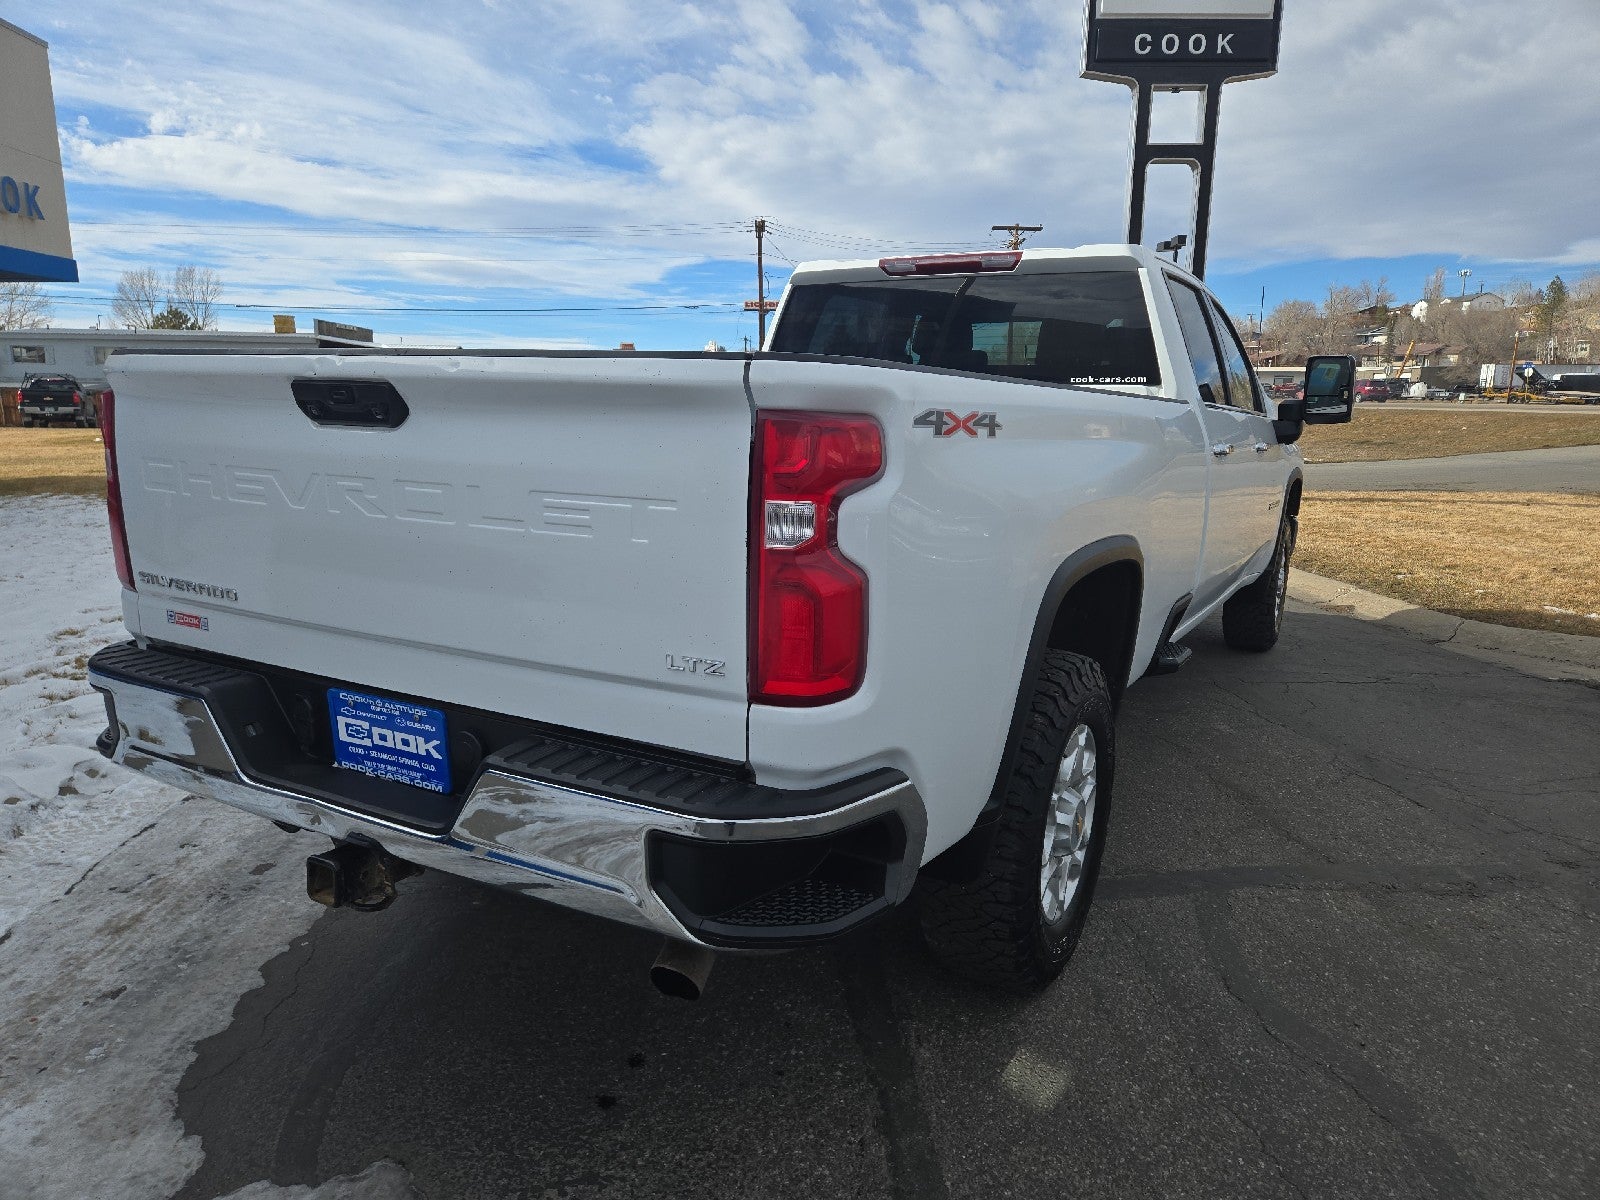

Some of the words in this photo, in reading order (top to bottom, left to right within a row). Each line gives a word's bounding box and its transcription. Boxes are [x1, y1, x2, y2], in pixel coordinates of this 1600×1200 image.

[1134, 33, 1235, 54] COOK
[1070, 375, 1147, 383] cook-cars.com
[142, 456, 678, 543] CHEVROLET
[138, 570, 238, 600] SILVERADO
[665, 654, 725, 676] LTZ
[385, 702, 427, 717] ALTITUDE
[407, 720, 436, 732] SUBARU
[337, 716, 442, 759] COOK
[341, 761, 443, 793] COOK-CARS.COM
